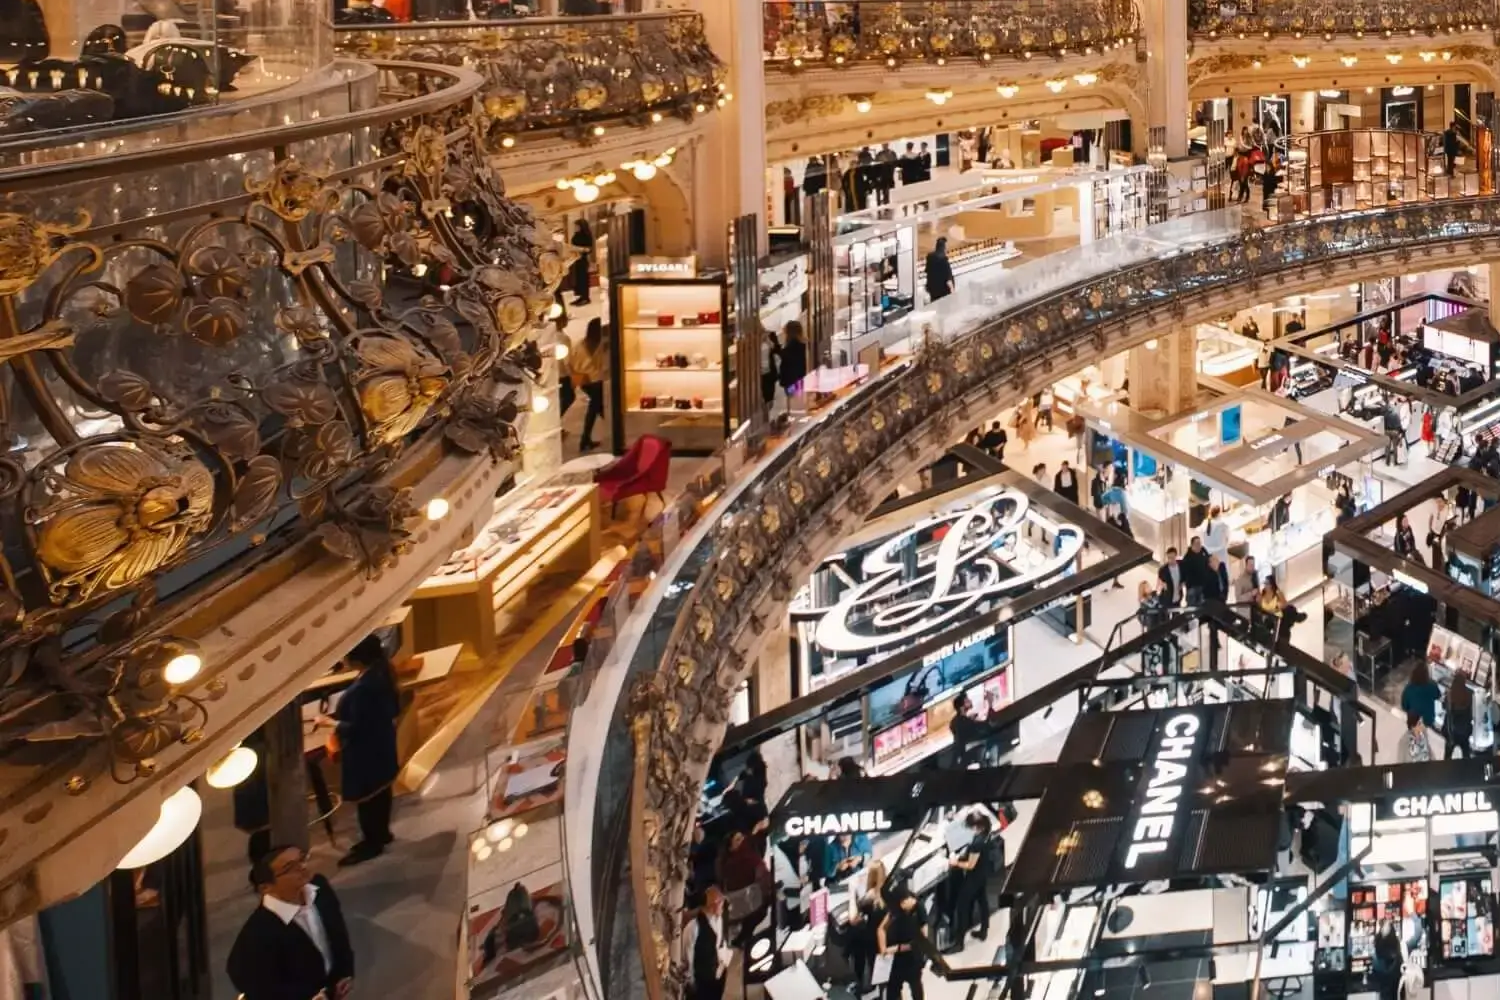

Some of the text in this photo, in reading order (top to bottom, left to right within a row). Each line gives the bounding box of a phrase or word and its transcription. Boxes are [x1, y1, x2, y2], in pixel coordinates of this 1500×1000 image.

[1125, 713, 1200, 869] CHANEL
[1393, 790, 1492, 817] CHANEL
[784, 809, 892, 837] CHANEL
